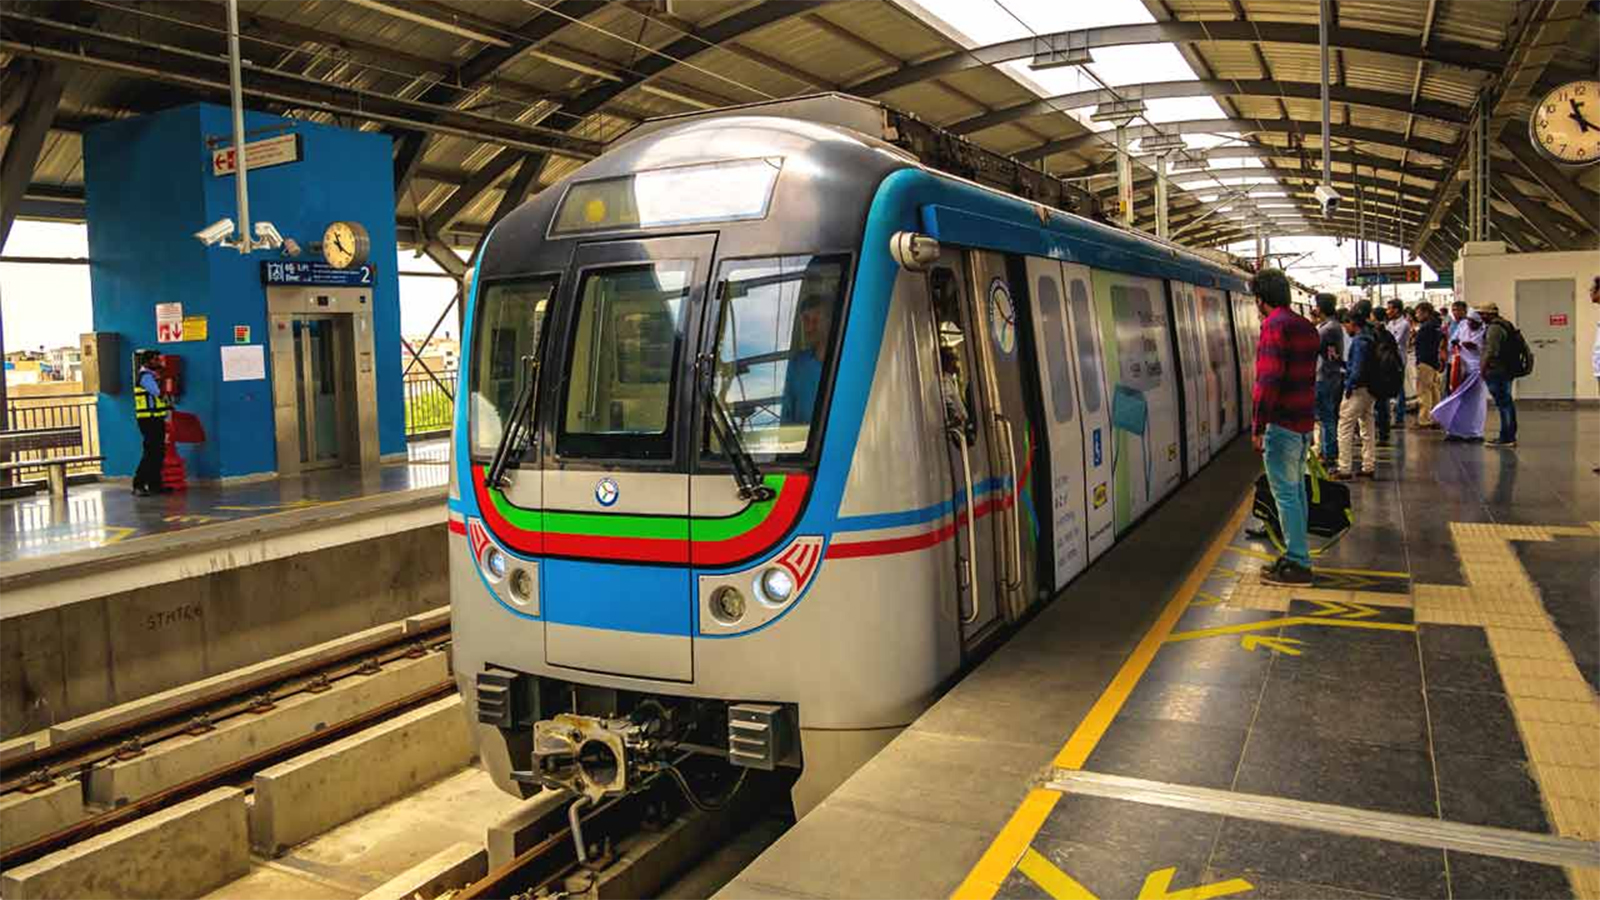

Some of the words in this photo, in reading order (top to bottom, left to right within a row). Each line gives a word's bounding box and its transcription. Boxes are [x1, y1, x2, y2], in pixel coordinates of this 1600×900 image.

[1575, 85, 1586, 96] 12
[1560, 92, 1568, 102] 11
[1546, 104, 1556, 114] 10
[1559, 143, 1568, 154] 7
[361, 266, 371, 283] 2
